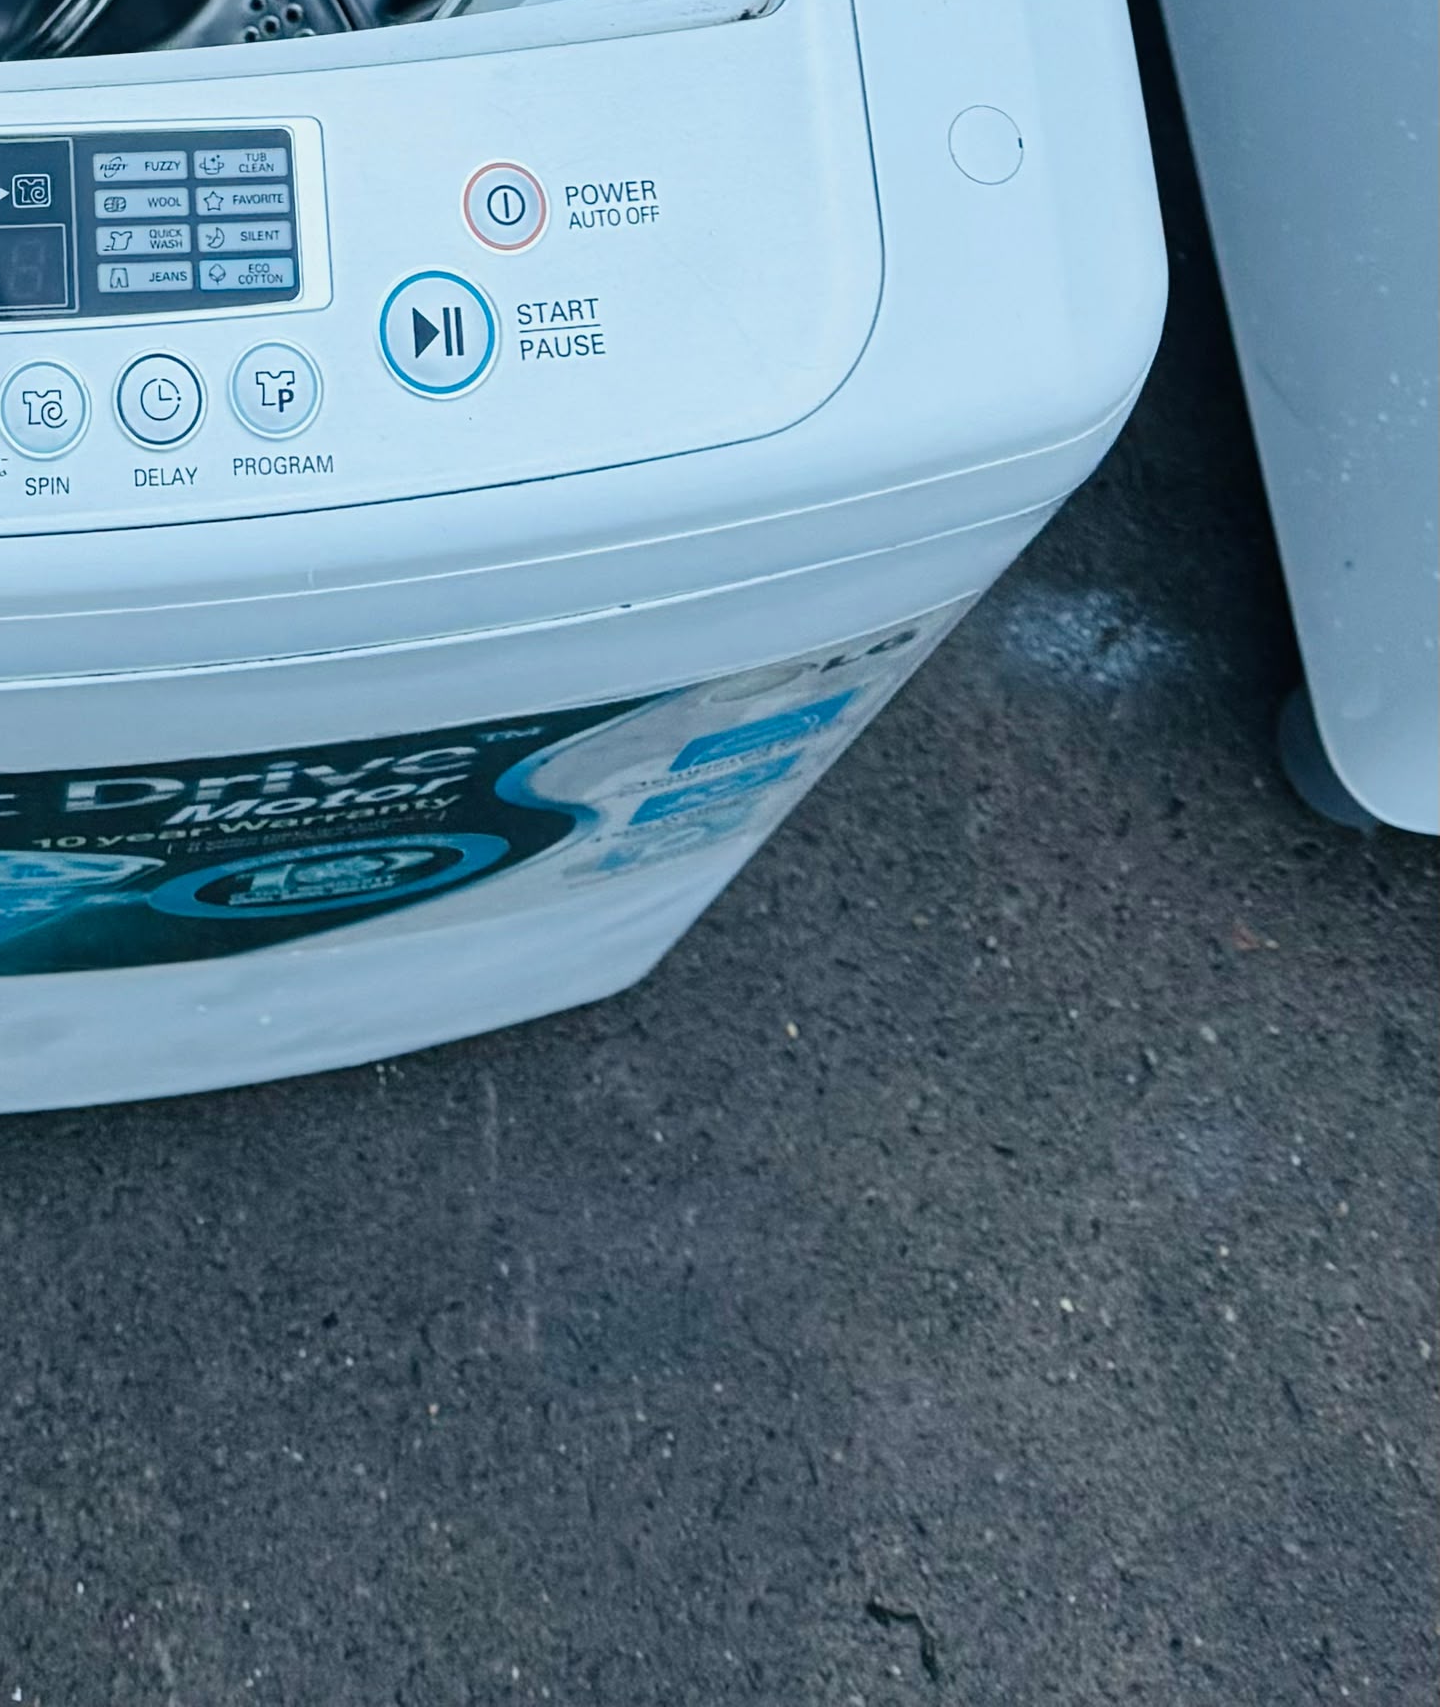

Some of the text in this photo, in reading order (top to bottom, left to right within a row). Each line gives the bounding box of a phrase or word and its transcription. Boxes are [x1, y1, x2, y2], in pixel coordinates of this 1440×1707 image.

[245, 152, 267, 163] TUB
[144, 161, 181, 172] FUZZY
[238, 162, 275, 174] CLEAN
[232, 193, 285, 206] FAVORITE
[564, 180, 657, 207] POWER
[147, 197, 182, 208] WOOL
[569, 204, 661, 231] AUTO OFF
[149, 228, 183, 239] QUICK
[240, 230, 280, 242] SILENT
[149, 239, 183, 249] WASH
[248, 263, 270, 274] ECO
[149, 271, 188, 283] JEANS
[238, 273, 284, 285] COTTON
[517, 297, 600, 326] START
[520, 333, 606, 361] PAUSE
[232, 455, 335, 477] PROGRAM
[133, 467, 199, 488] DELAY
[25, 476, 71, 497] SPIN
[65, 745, 479, 813] Drive
[163, 774, 469, 827] Motor
[32, 834, 87, 850] 10
[94, 823, 214, 849] year
[217, 793, 462, 835] Warranty
